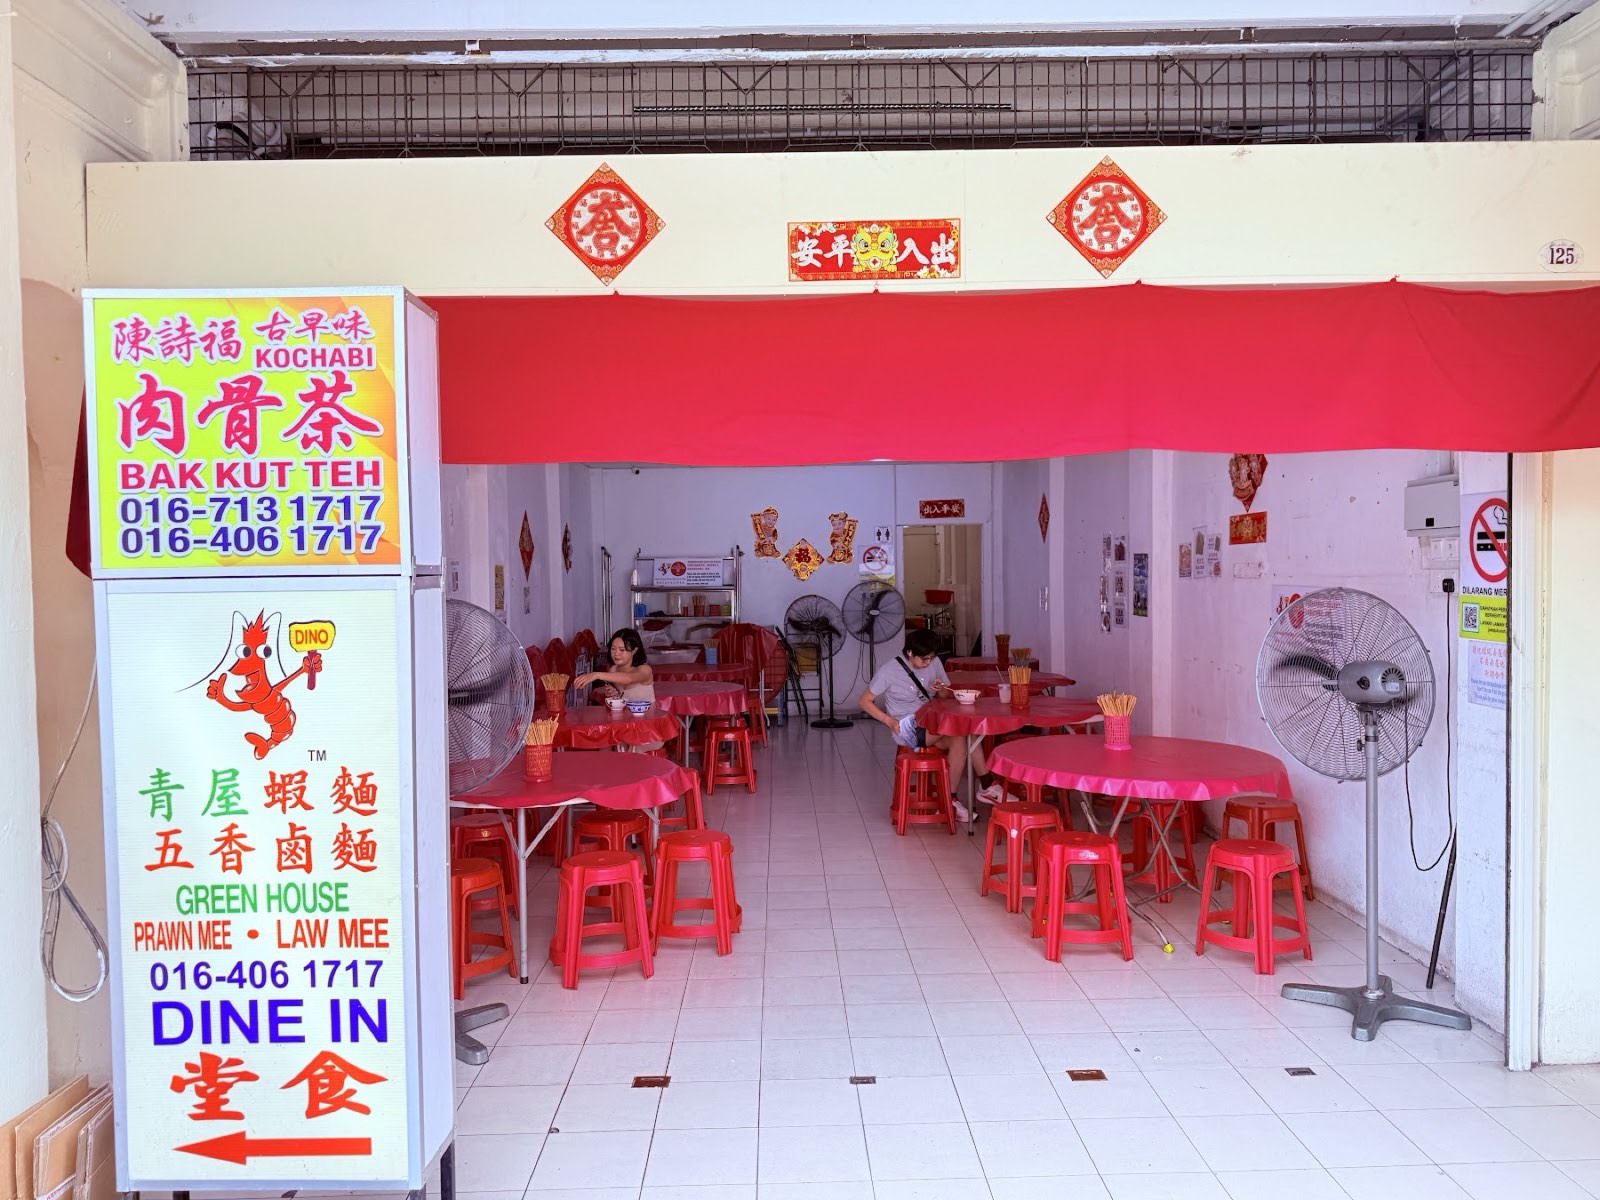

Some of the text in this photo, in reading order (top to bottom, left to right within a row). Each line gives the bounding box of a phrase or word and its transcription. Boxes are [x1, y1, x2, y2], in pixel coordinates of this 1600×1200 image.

[1549, 247, 1575, 265] 125
[114, 316, 243, 364] 陳詩福
[255, 309, 373, 344] 古早味
[255, 348, 373, 369] KOCHABI
[118, 370, 383, 455] 肉骨茶
[121, 460, 381, 490] BAK KUT TEH
[121, 495, 381, 524] 016-713 1717
[121, 525, 382, 554] 016-406 1717
[1462, 586, 1492, 596] DILARANG
[295, 629, 329, 645] DINO
[308, 750, 327, 762] TM
[138, 766, 378, 822] 青屋蝦麵
[176, 881, 350, 915] GREEN HOUSE
[134, 918, 390, 951] PRAWN MEE LAW MEE
[150, 959, 384, 991] 016-406 1717
[152, 998, 388, 1045] DINE IN
[170, 1050, 389, 1121] 堂食
